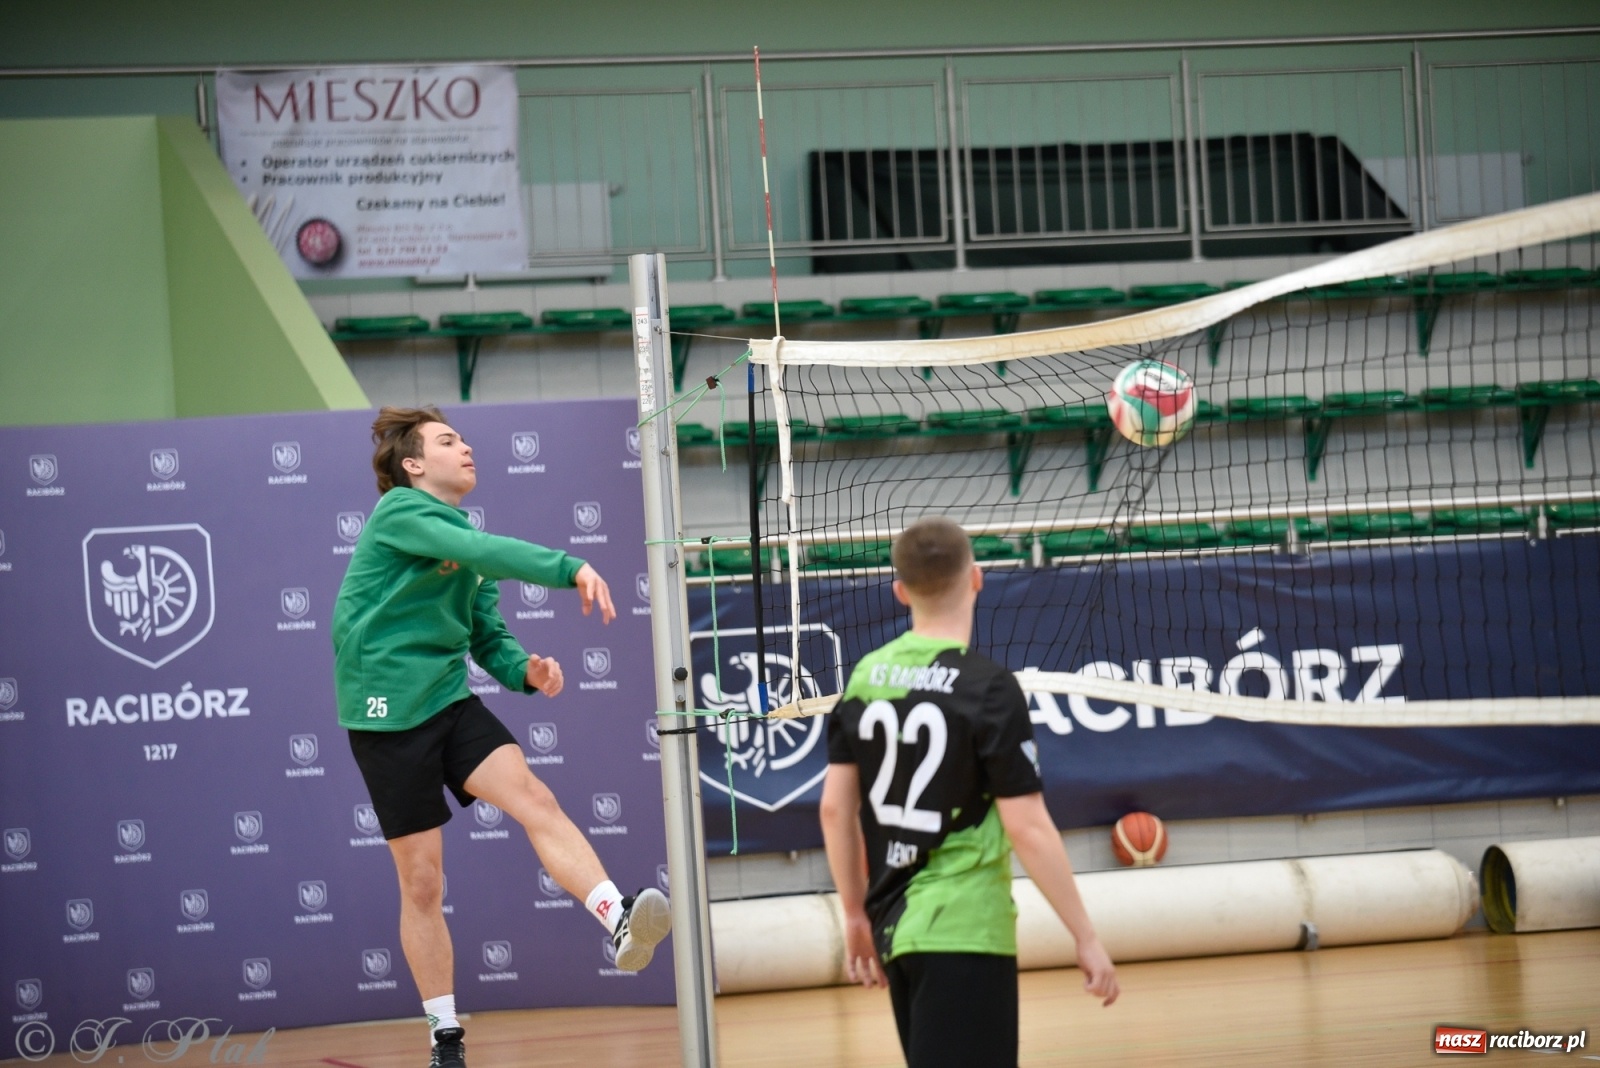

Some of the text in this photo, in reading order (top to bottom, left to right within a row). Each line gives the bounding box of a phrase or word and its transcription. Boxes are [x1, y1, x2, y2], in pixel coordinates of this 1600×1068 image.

[254, 75, 481, 123] MIESZKO
[261, 154, 328, 171] Operator
[410, 148, 516, 166] cukierniczych
[262, 170, 443, 187] Pracownik produkcyjny
[356, 196, 424, 212] Czekamy
[429, 197, 449, 209] na
[869, 661, 960, 694] KS RACIBÓRZ
[1023, 626, 1405, 735] ACIBÓRZ
[66, 681, 250, 727] RACIBÓRZ
[366, 696, 388, 718] 25
[143, 743, 178, 761] 1217
[859, 699, 948, 832] 22
